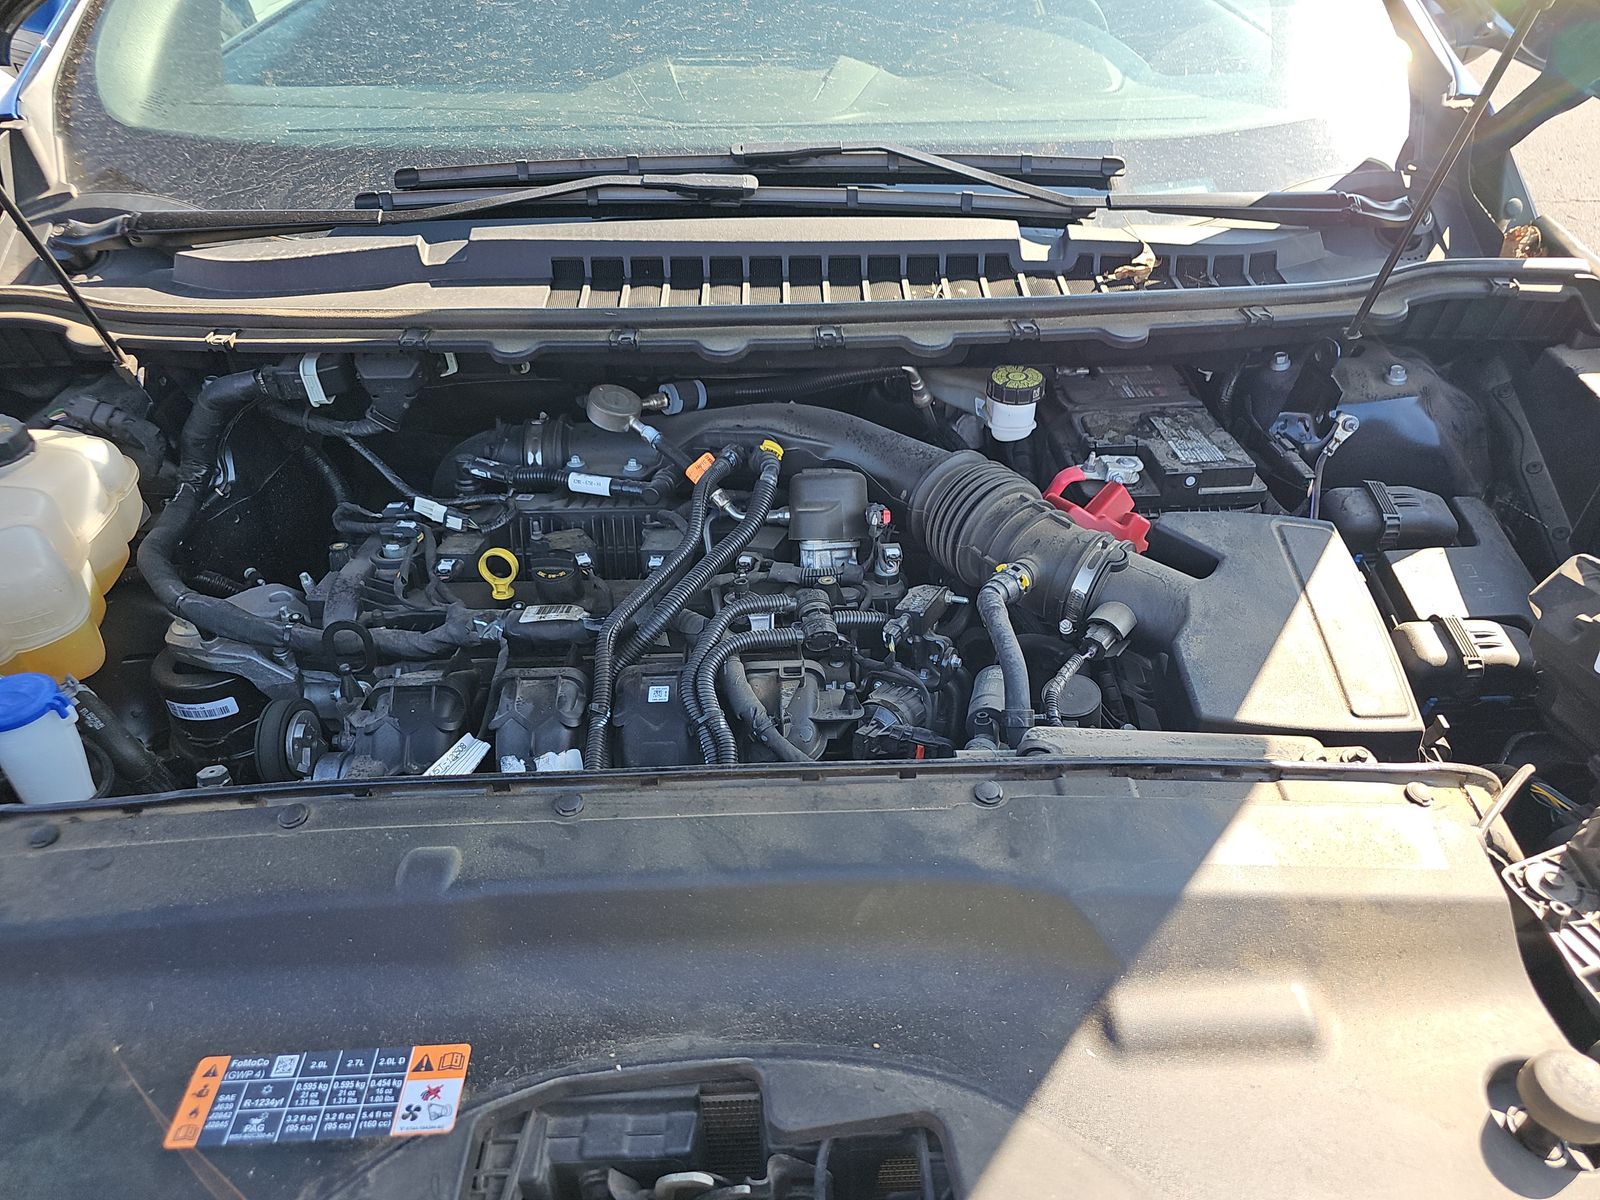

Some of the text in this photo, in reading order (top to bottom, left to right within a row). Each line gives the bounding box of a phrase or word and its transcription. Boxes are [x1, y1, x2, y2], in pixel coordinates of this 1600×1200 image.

[230, 1058, 270, 1068] FoMoCo
[310, 1060, 328, 1069] 2.0L
[347, 1059, 365, 1068] 2.7L
[379, 1057, 406, 1066] 2.0L D
[224, 1070, 266, 1080] (GWP 4)
[296, 1082, 329, 1092] 0.595 kg
[333, 1080, 366, 1090] 0.595 kg
[370, 1079, 403, 1088] 0.454 kg
[218, 1094, 237, 1102] SAE
[243, 1097, 285, 1107] R-1234yf
[286, 1115, 300, 1123] 3.2
[324, 1113, 338, 1121] 3.2
[243, 1123, 266, 1133] PAG
[285, 1123, 314, 1133] (95 cc)
[324, 1122, 352, 1131] (95 cc)
[378, 1120, 391, 1128] cc)
